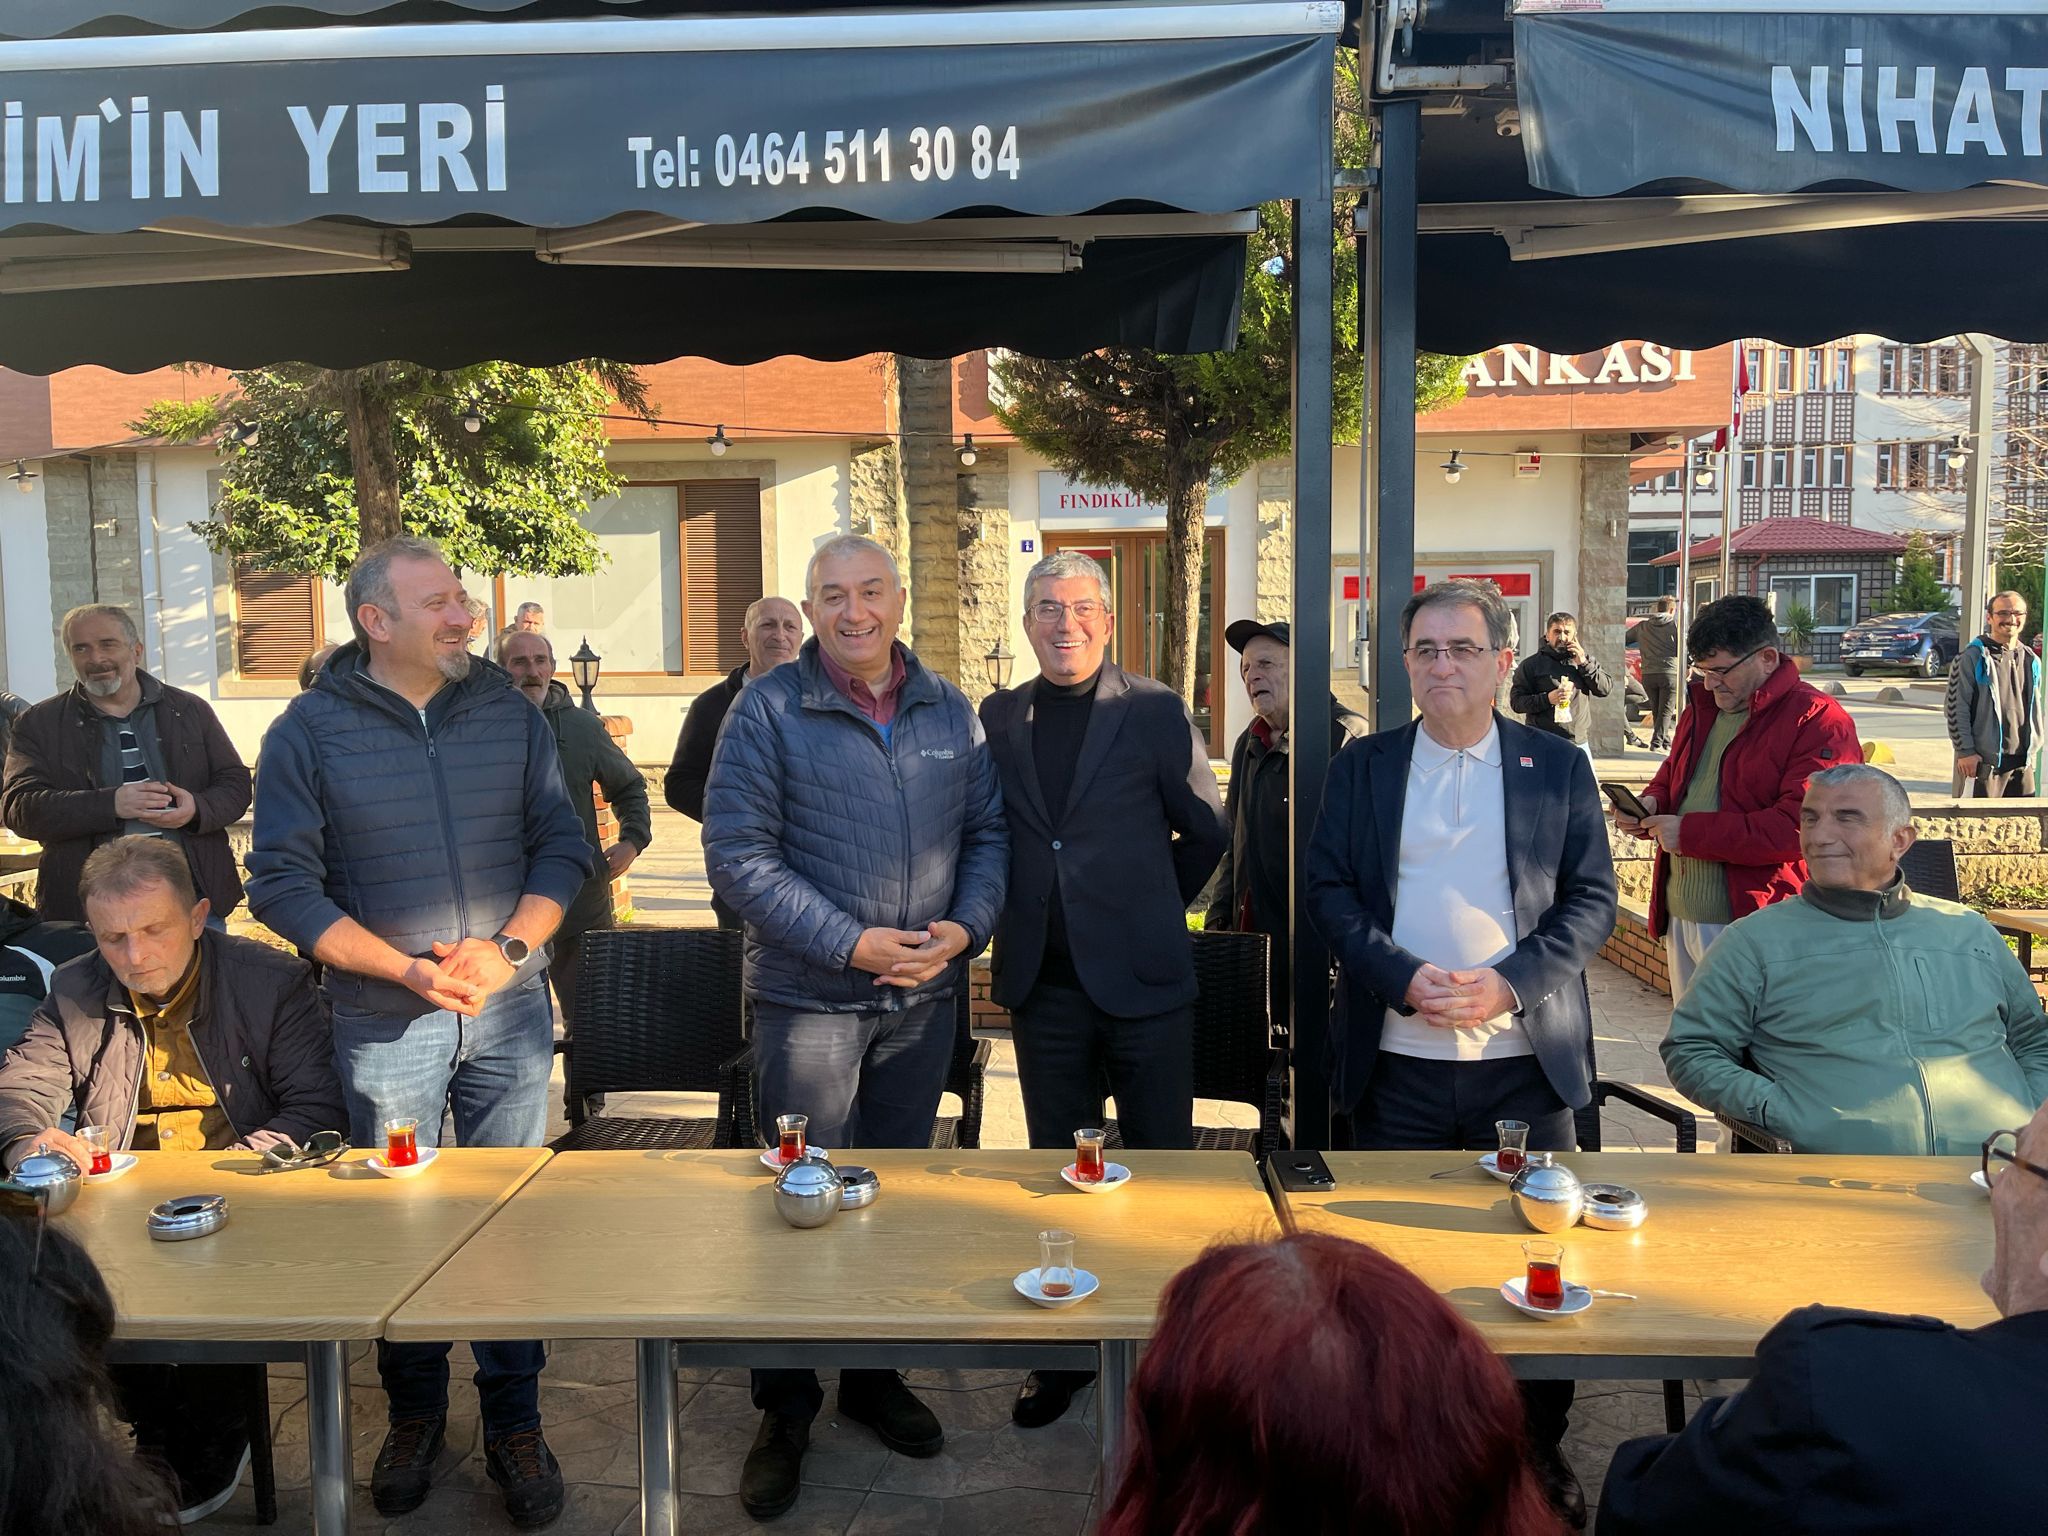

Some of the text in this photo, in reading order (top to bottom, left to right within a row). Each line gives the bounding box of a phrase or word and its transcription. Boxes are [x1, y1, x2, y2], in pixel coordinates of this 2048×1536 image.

[287, 84, 507, 194] YERİ
[1771, 48, 2048, 156] NİHAT
[628, 124, 1020, 189] Tel: 0464 511 30 84
[1060, 493, 1141, 509] FINDIKLI
